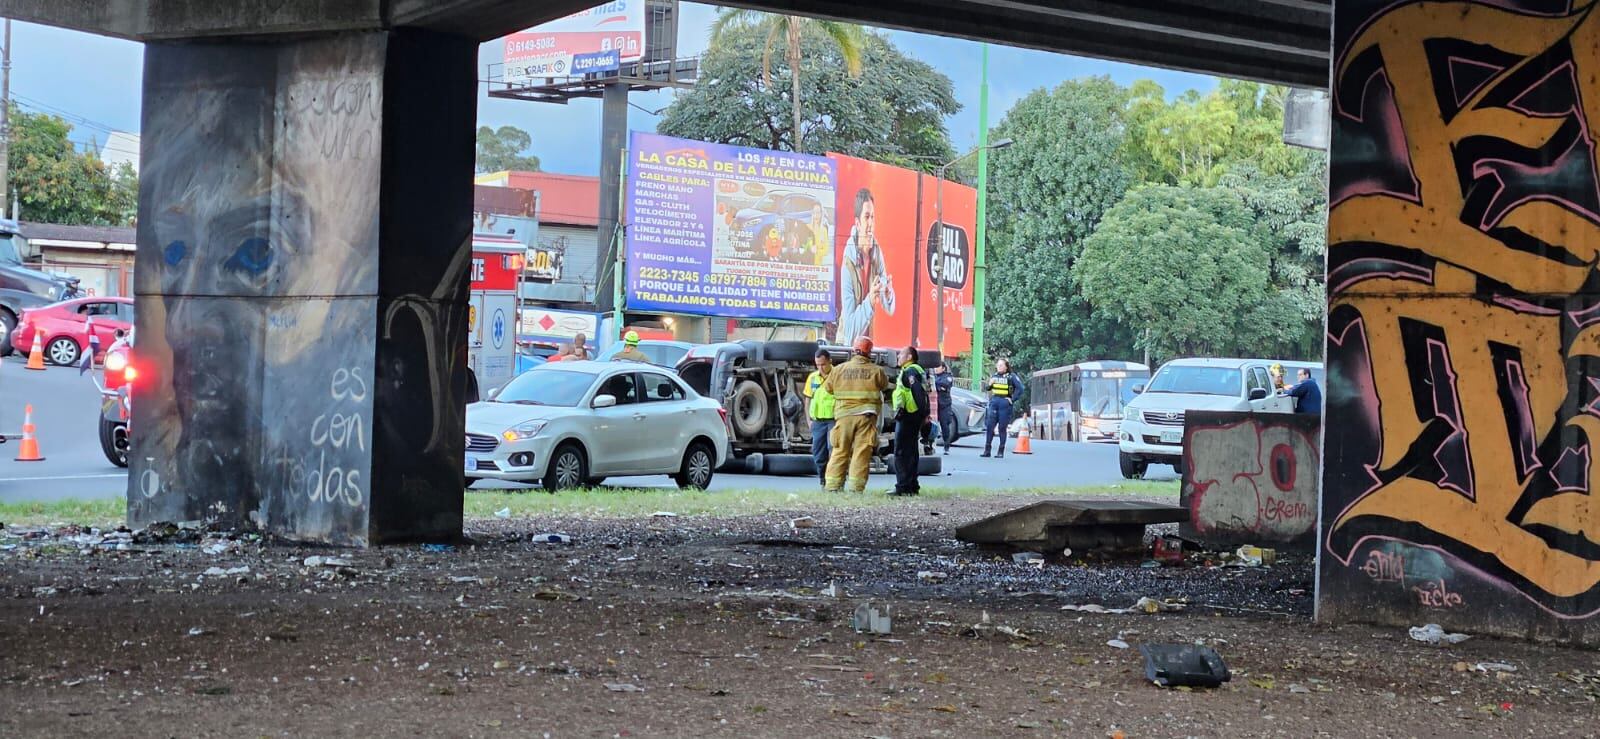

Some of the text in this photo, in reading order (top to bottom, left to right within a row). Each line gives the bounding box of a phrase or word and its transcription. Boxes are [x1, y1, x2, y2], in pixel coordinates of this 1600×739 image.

[639, 151, 830, 184] LA CASA DE LA MÁQUINA
[738, 152, 760, 164] LOS
[763, 156, 777, 166] #1
[780, 158, 794, 168] EN
[639, 171, 679, 184] CABLES
[681, 177, 711, 187] PARA:
[635, 181, 693, 194] FRENO MANO
[635, 190, 679, 201] MARCHAS
[635, 198, 654, 206] GAS
[660, 201, 690, 211] CLUTH
[635, 207, 697, 220] VELOCÍMETRO
[635, 216, 681, 227] ELEVADOR
[634, 225, 706, 239] LÍNEA MARÍTIMA
[634, 234, 706, 248] LÍNEA AGRÍCOLA
[939, 226, 961, 256] ULL
[643, 253, 675, 263] MUCHO
[931, 252, 965, 284] CARO
[639, 266, 830, 292] 2223-7345 8797-7894 6001-0333
[639, 280, 684, 292] PORQUE
[686, 284, 701, 293] LA
[703, 286, 748, 296] CALIDAD
[751, 289, 781, 298] TIENE
[783, 291, 826, 301] NOMBRE
[635, 291, 830, 313] TRABAJAMOS TODAS LAS MARCAS
[331, 366, 366, 402] es
[310, 413, 365, 453] con
